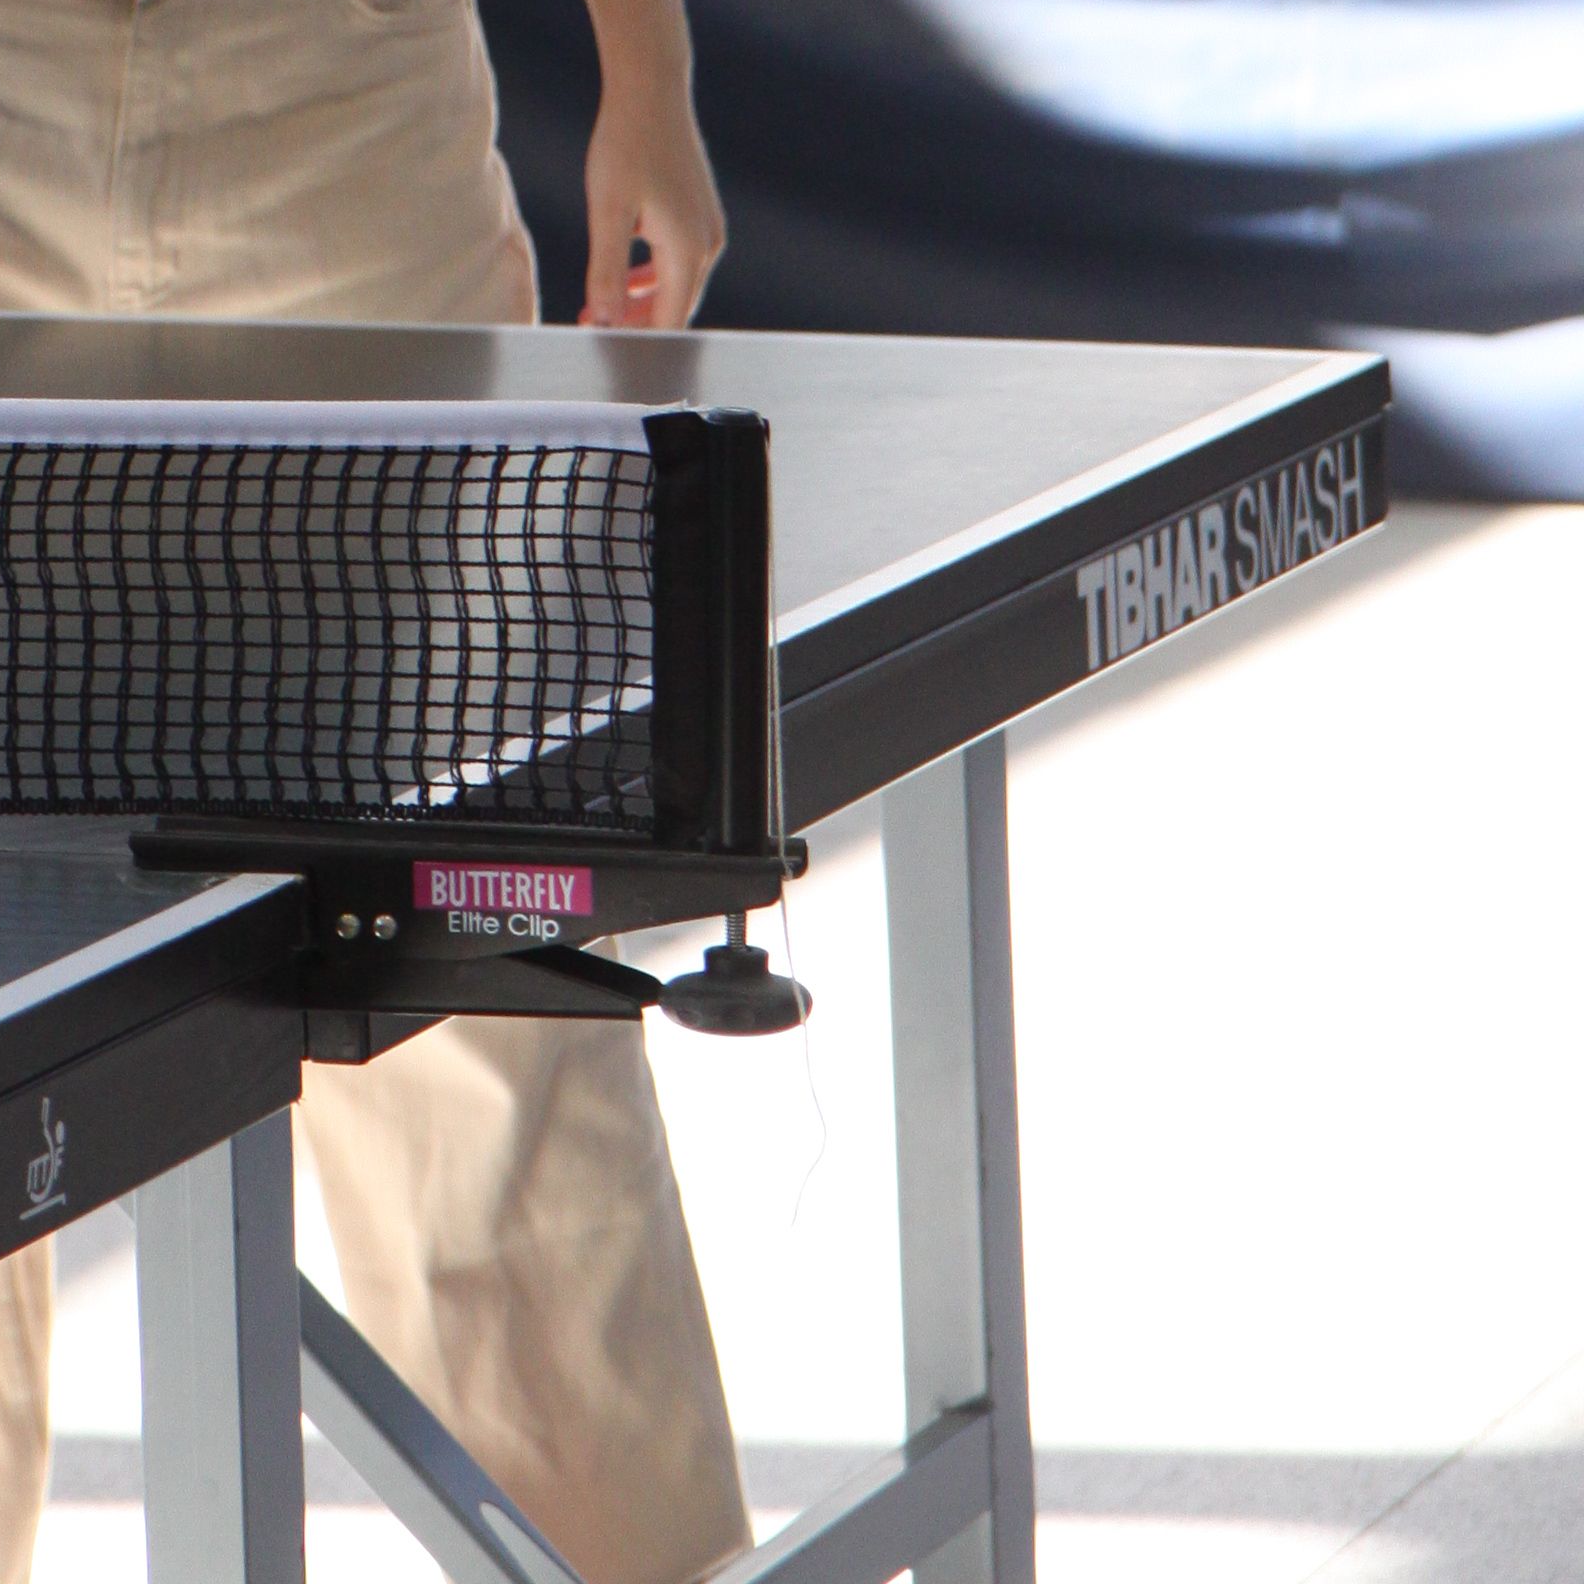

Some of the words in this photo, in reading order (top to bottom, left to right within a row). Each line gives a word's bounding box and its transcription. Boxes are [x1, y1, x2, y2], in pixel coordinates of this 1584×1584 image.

[1076, 502, 1229, 671] TIBHAR
[1234, 434, 1366, 594] SMASH
[431, 869, 575, 911] BUTTERFLY
[448, 911, 500, 935] Elite
[507, 913, 560, 942] Clip
